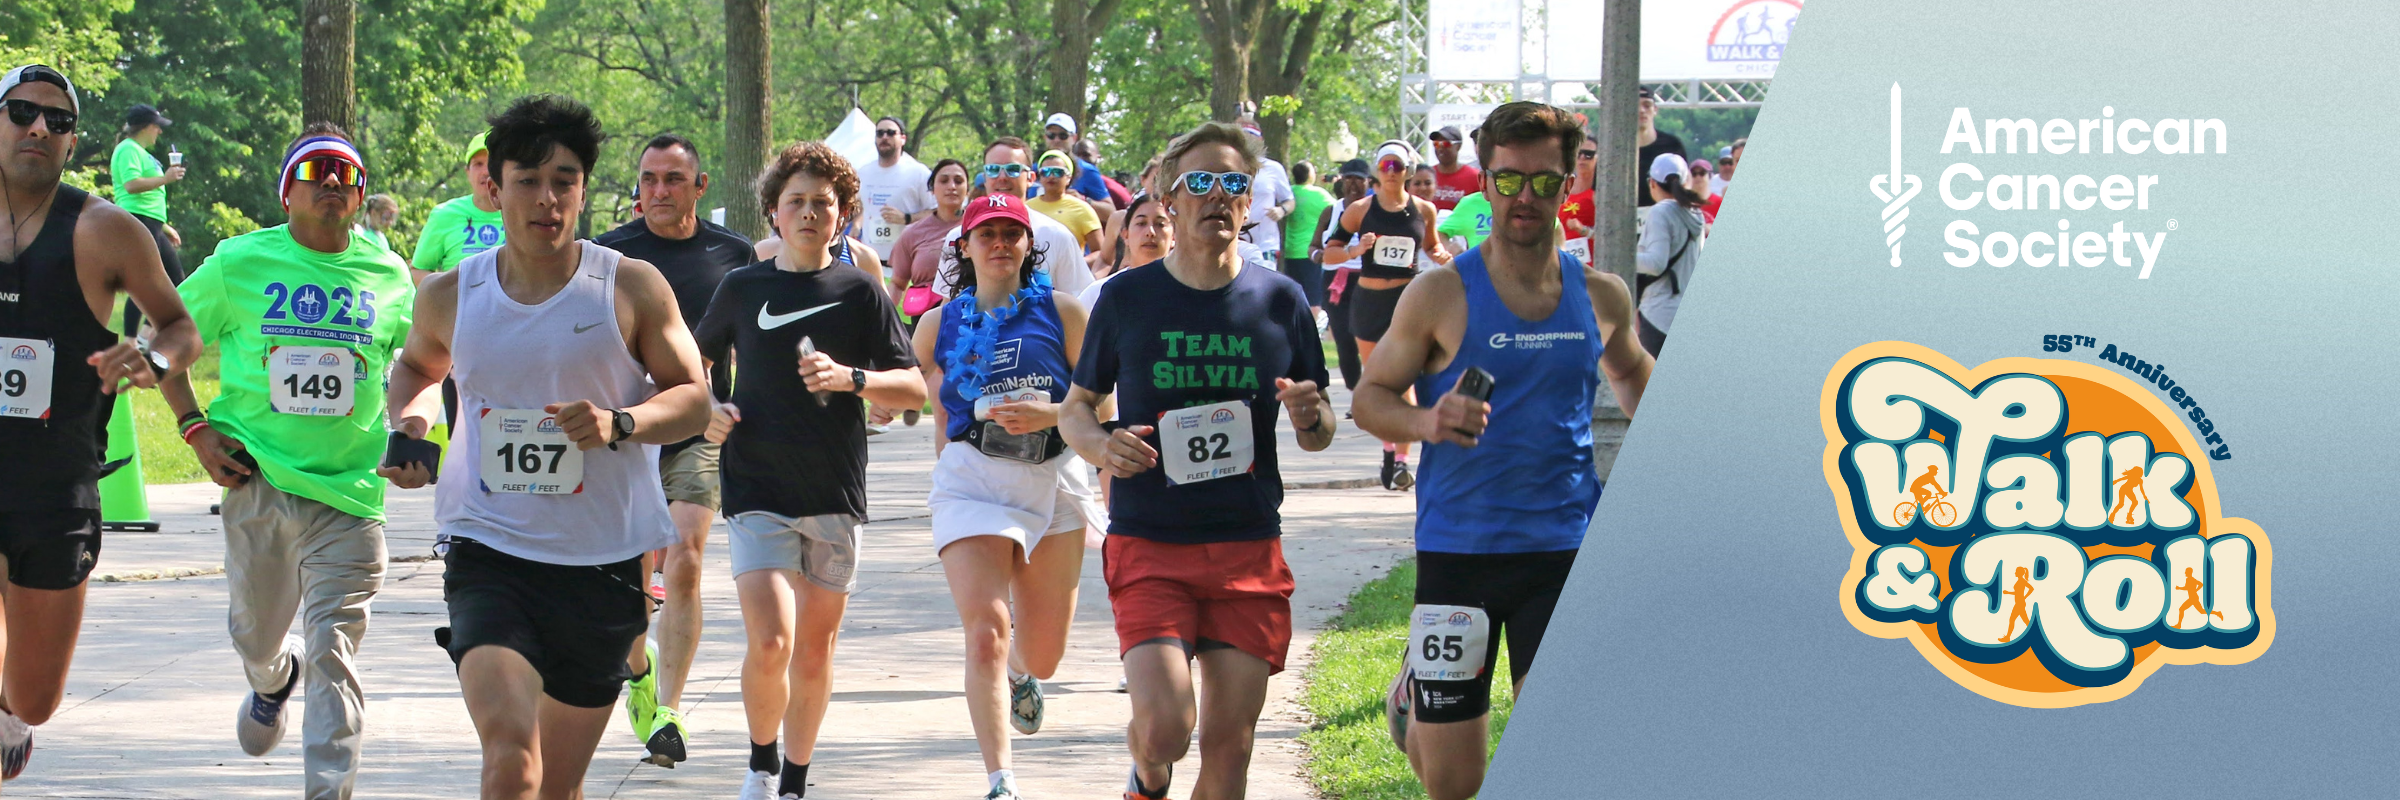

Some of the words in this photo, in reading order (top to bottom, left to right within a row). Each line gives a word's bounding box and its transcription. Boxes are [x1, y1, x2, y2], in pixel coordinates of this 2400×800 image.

[1711, 46, 1763, 59] WALK
[1766, 46, 1780, 59] &
[1441, 113, 1467, 121] START
[876, 227, 891, 238] 68
[1381, 246, 1408, 259] 137
[1568, 247, 1585, 258] 29
[262, 281, 376, 329] 2025
[262, 327, 295, 335] CHICAGO
[296, 328, 339, 339] ELECTRICAL
[1515, 331, 1585, 342] ENDORPHINS
[993, 346, 1016, 355] merican
[1160, 331, 1252, 358] TEAM
[1515, 341, 1553, 349] RUNNING
[1152, 361, 1260, 390] SILVIA
[0, 368, 27, 398] 9
[283, 373, 343, 400] 149
[979, 372, 1053, 395] ermiNation
[9, 406, 30, 415] FEET
[289, 406, 309, 414] FLEET
[1187, 432, 1231, 464] 82
[497, 442, 567, 474] 167
[1186, 471, 1210, 480] FLEET
[1219, 466, 1237, 475] FEET
[502, 483, 527, 492] FLEET
[538, 484, 560, 492] FEET
[1422, 634, 1463, 662] 65
